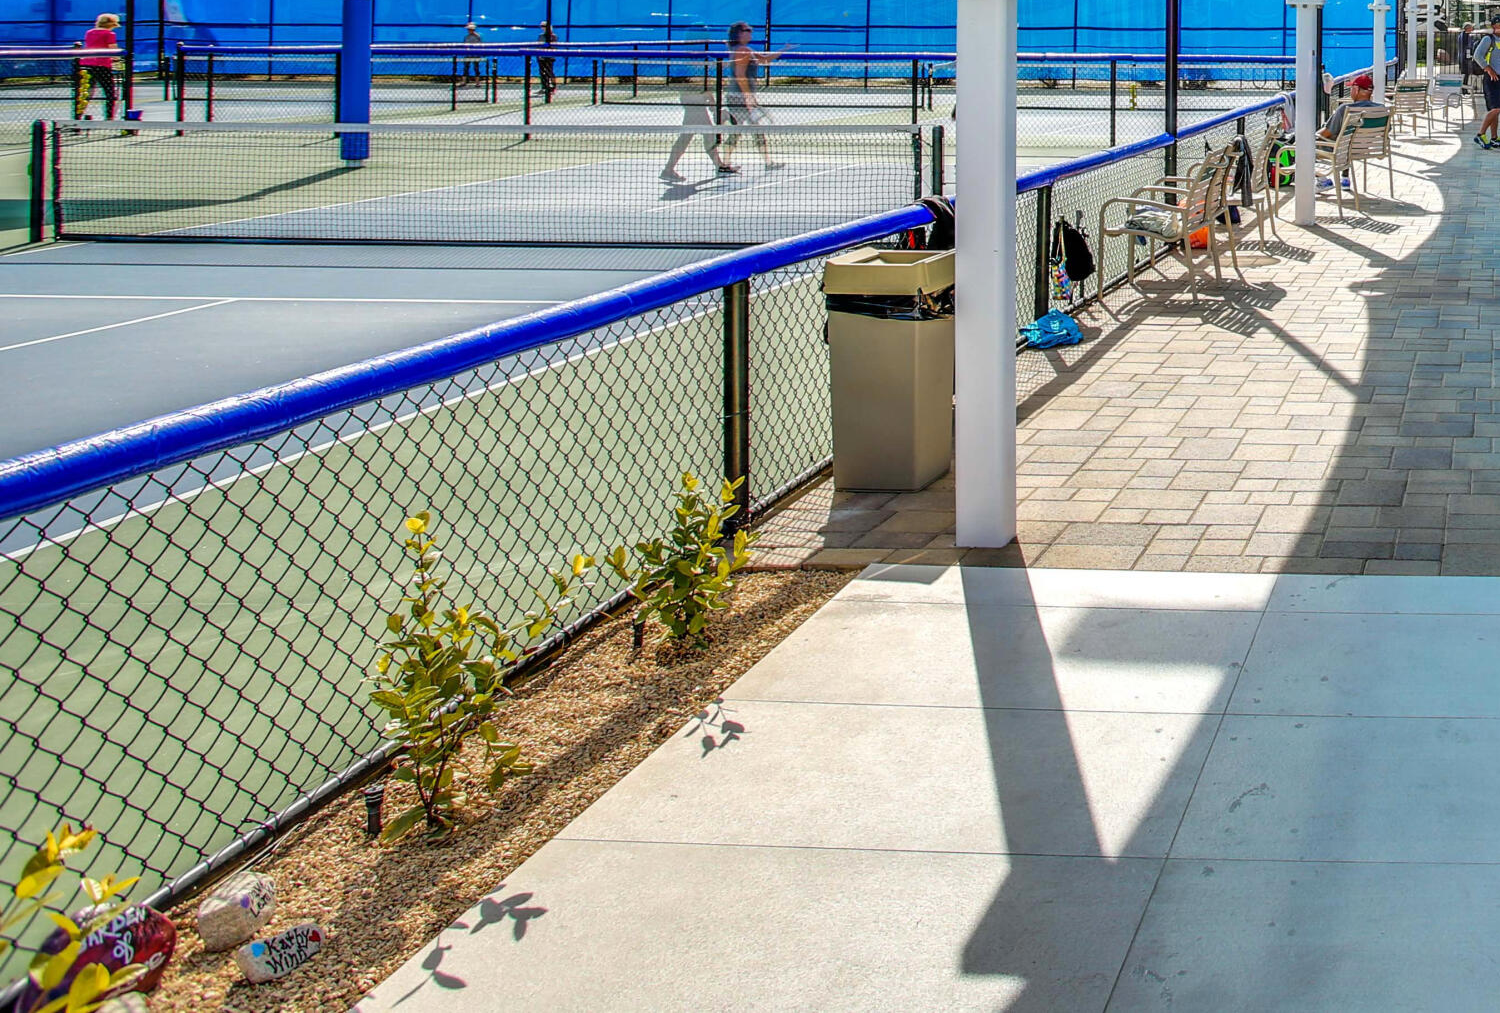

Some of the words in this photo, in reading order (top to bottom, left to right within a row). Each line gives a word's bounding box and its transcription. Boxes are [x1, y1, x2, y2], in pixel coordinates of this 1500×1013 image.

[113, 930, 134, 966] of
[264, 927, 310, 956] Kathy
[265, 949, 307, 974] Winn
